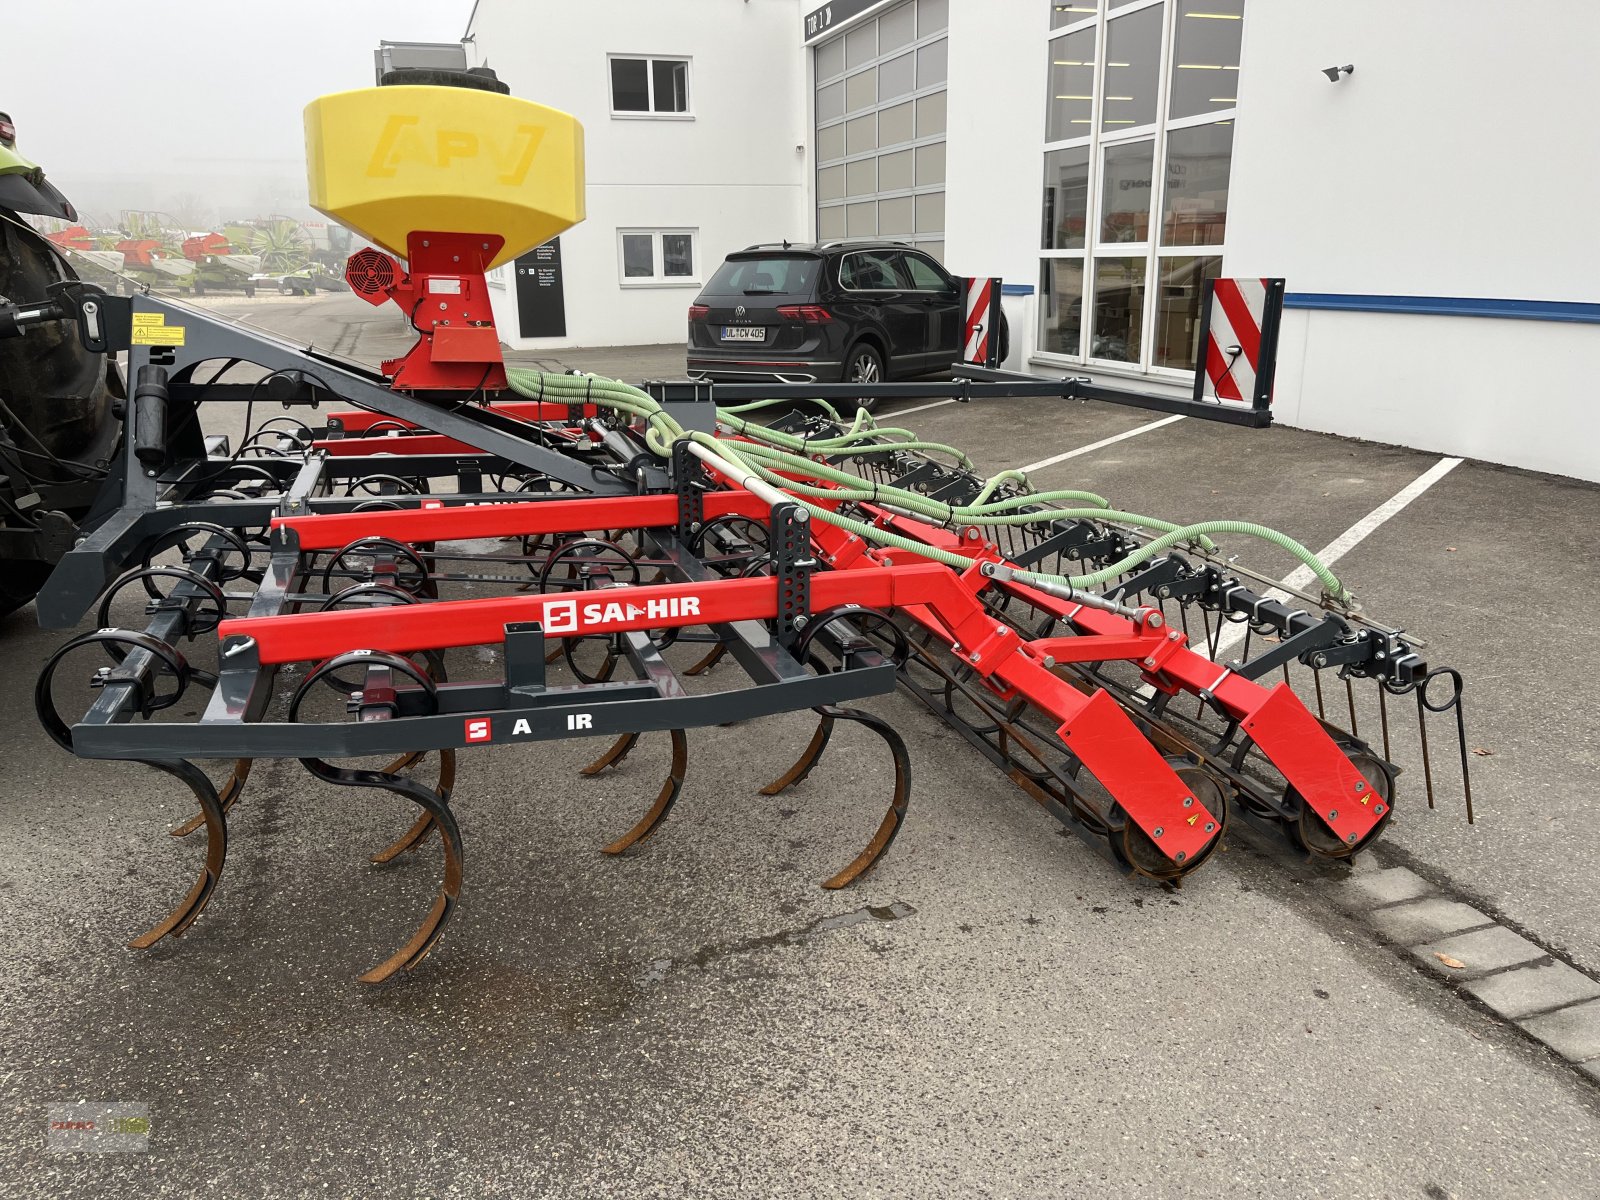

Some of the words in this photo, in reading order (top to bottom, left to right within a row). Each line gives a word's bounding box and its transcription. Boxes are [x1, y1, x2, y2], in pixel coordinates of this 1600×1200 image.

[726, 328, 735, 338] UL
[740, 328, 750, 338] CW
[750, 328, 764, 338] 405
